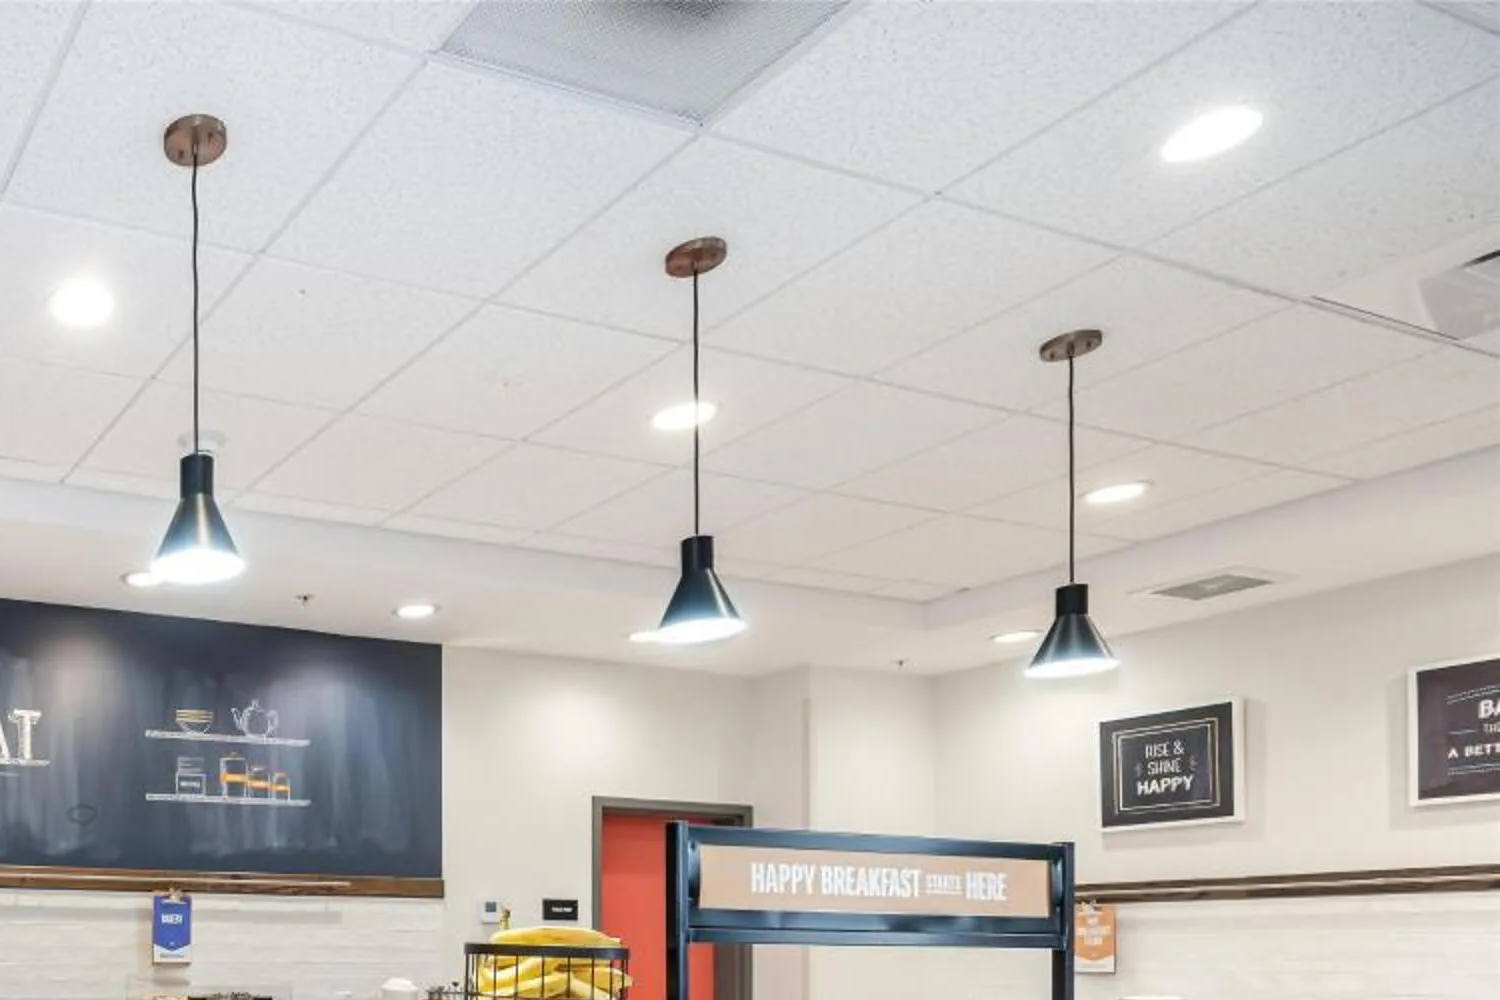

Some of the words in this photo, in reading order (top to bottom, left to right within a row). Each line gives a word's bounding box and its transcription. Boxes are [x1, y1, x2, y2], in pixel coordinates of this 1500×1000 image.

[1145, 741, 1170, 759] RISE
[1173, 740, 1184, 755] &
[1447, 747, 1459, 760] A
[1147, 758, 1181, 775] SHINE
[1136, 774, 1194, 796] HAPPY
[751, 861, 816, 895] HAPPY
[820, 865, 923, 898] BREAKFAST
[965, 871, 1008, 901] HERE
